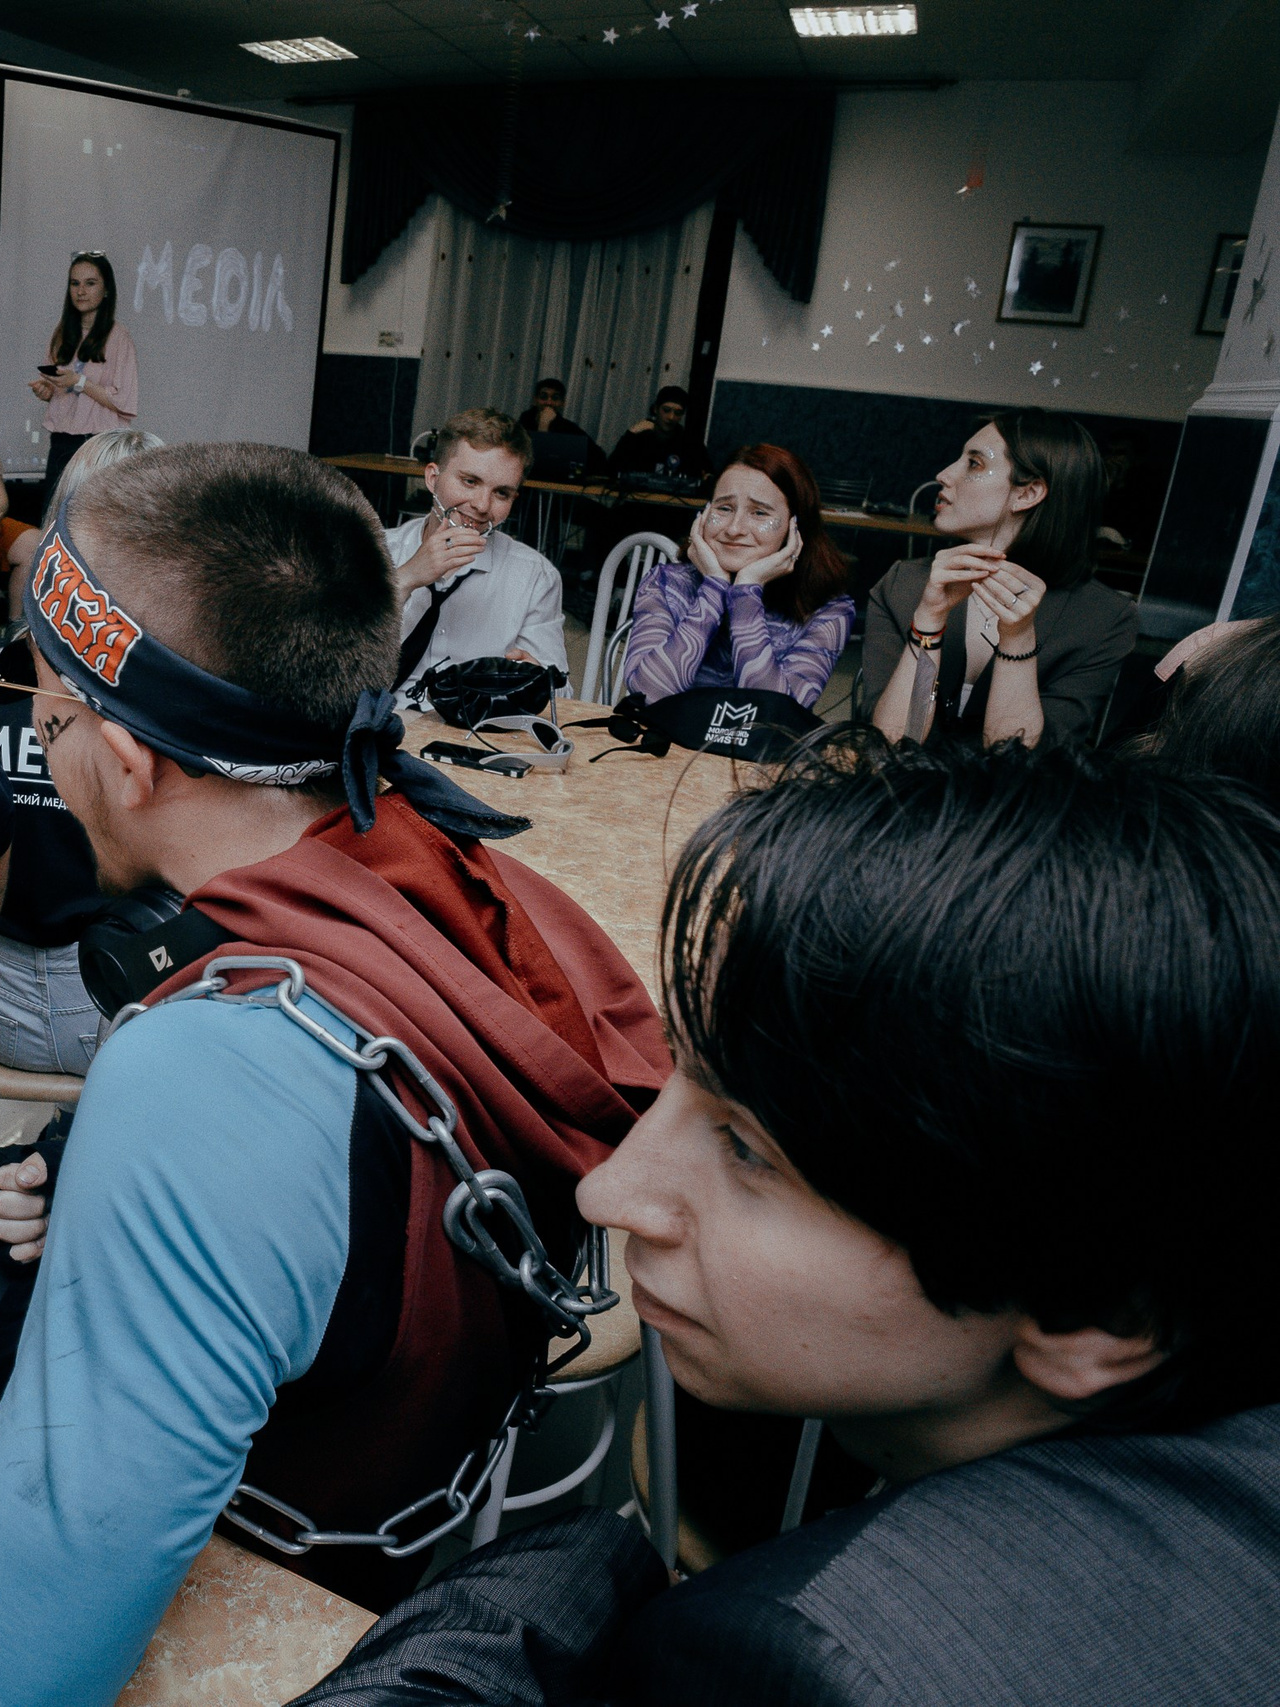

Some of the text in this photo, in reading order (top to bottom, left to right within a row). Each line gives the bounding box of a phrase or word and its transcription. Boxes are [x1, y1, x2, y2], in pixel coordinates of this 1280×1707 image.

[133, 241, 294, 332] MEDIA
[12, 793, 69, 810] СКИЙ МЕД
